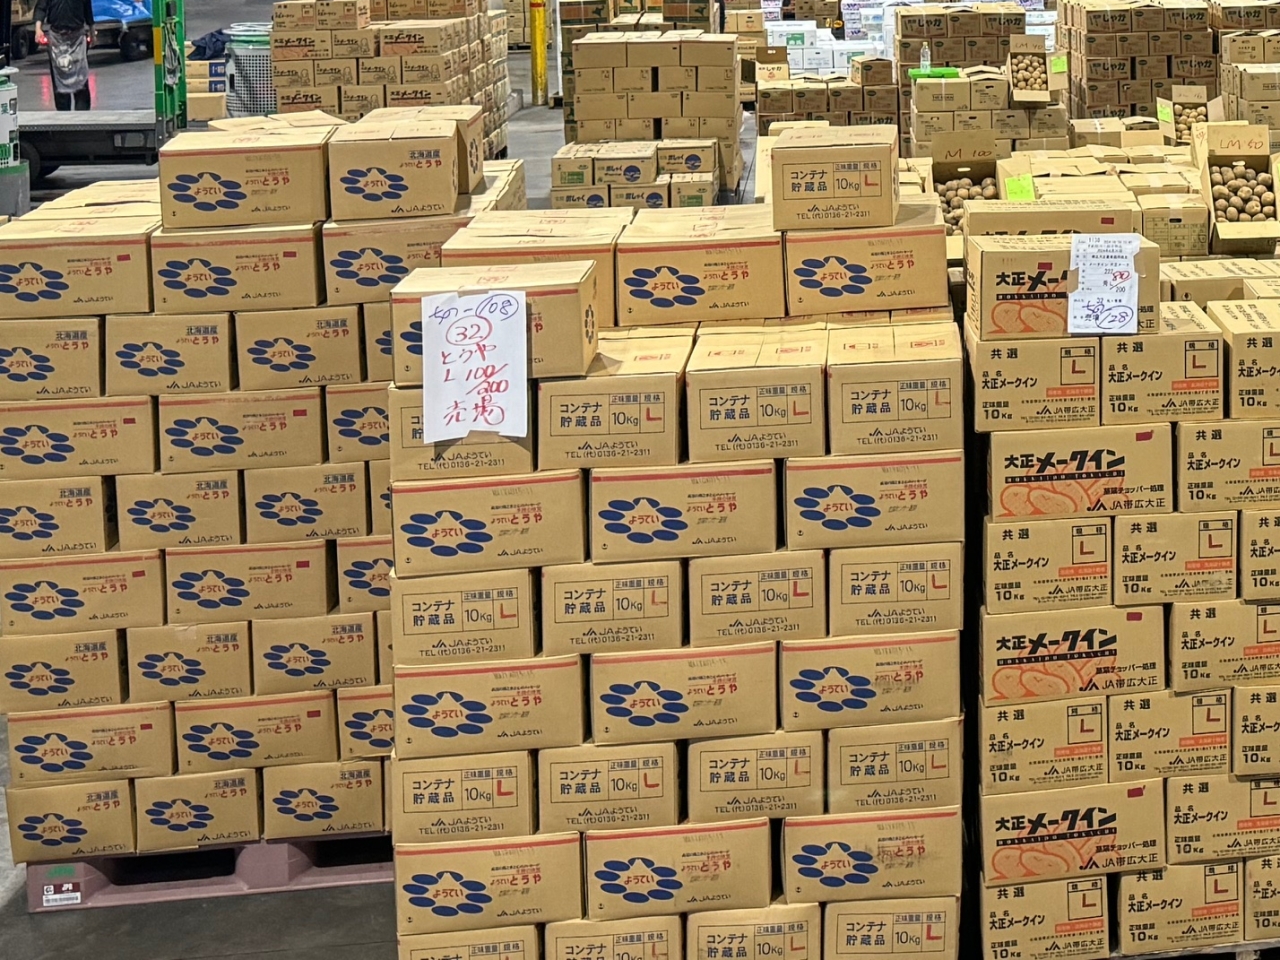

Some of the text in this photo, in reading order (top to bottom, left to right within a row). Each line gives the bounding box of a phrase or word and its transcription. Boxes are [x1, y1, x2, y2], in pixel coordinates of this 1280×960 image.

[409, 150, 441, 160] 北海道産
[945, 149, 962, 159] M
[790, 171, 827, 181] コンテナ
[362, 178, 388, 189] ようてい
[791, 175, 878, 192] 貯蔵品 10Kg L
[820, 271, 848, 280] ようてい
[651, 281, 681, 291] ようてい
[185, 326, 218, 336] 北海道産
[455, 324, 483, 342] 32
[138, 352, 164, 362] ようてい
[1108, 370, 1162, 383] 大正メークイン
[982, 377, 1037, 390] 大正メークイン
[708, 395, 751, 407] コンテナ
[1178, 399, 1219, 407] JA帯広大正
[559, 403, 600, 414] コンテナ
[709, 403, 809, 420] 貯蔵品 10Kg L
[560, 408, 662, 427] 貯蔵品 10Kg L
[1005, 449, 1125, 473] 大正メークイン
[196, 480, 228, 490] 北海道産
[1109, 498, 1166, 510] JA帯広大正
[199, 584, 226, 593] ようてい
[708, 580, 750, 593] コンテナ
[710, 582, 809, 605] 貯蔵品 10Kg L
[74, 643, 106, 653] 北海道産
[412, 780, 455, 792] コンテナ
[86, 790, 118, 800] 北海道産
[413, 781, 514, 805] 貯蔵品 10Kg L
[995, 807, 1117, 835] 大正メークイン
[1102, 853, 1158, 867] JA帯広大正
